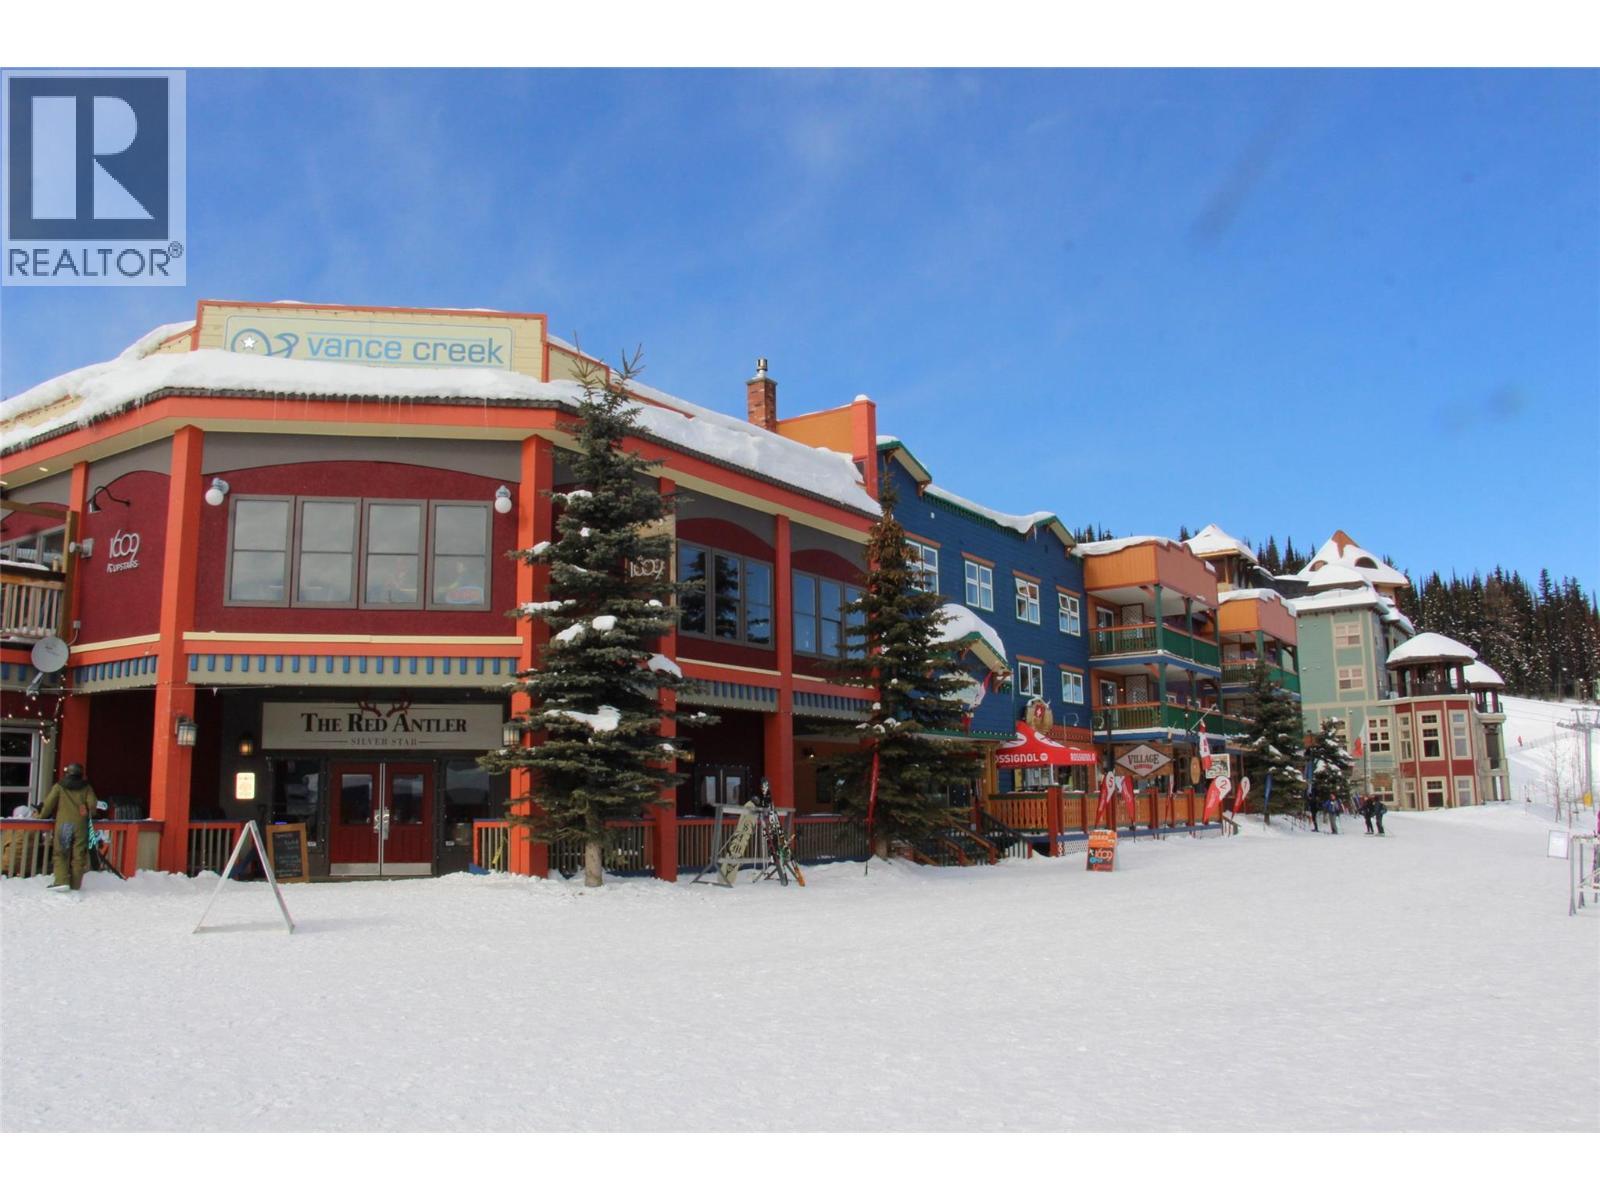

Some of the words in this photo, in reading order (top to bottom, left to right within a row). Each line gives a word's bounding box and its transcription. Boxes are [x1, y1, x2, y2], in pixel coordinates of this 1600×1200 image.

[307, 335, 402, 360] vance
[412, 338, 504, 364] creek
[109, 529, 140, 561] 1609
[351, 737, 387, 746] SILVER
[392, 738, 417, 746] STAR
[992, 753, 1039, 763] OSSIGNOL
[1127, 753, 1160, 765] VILLAGE
[1220, 779, 1228, 789] 2
